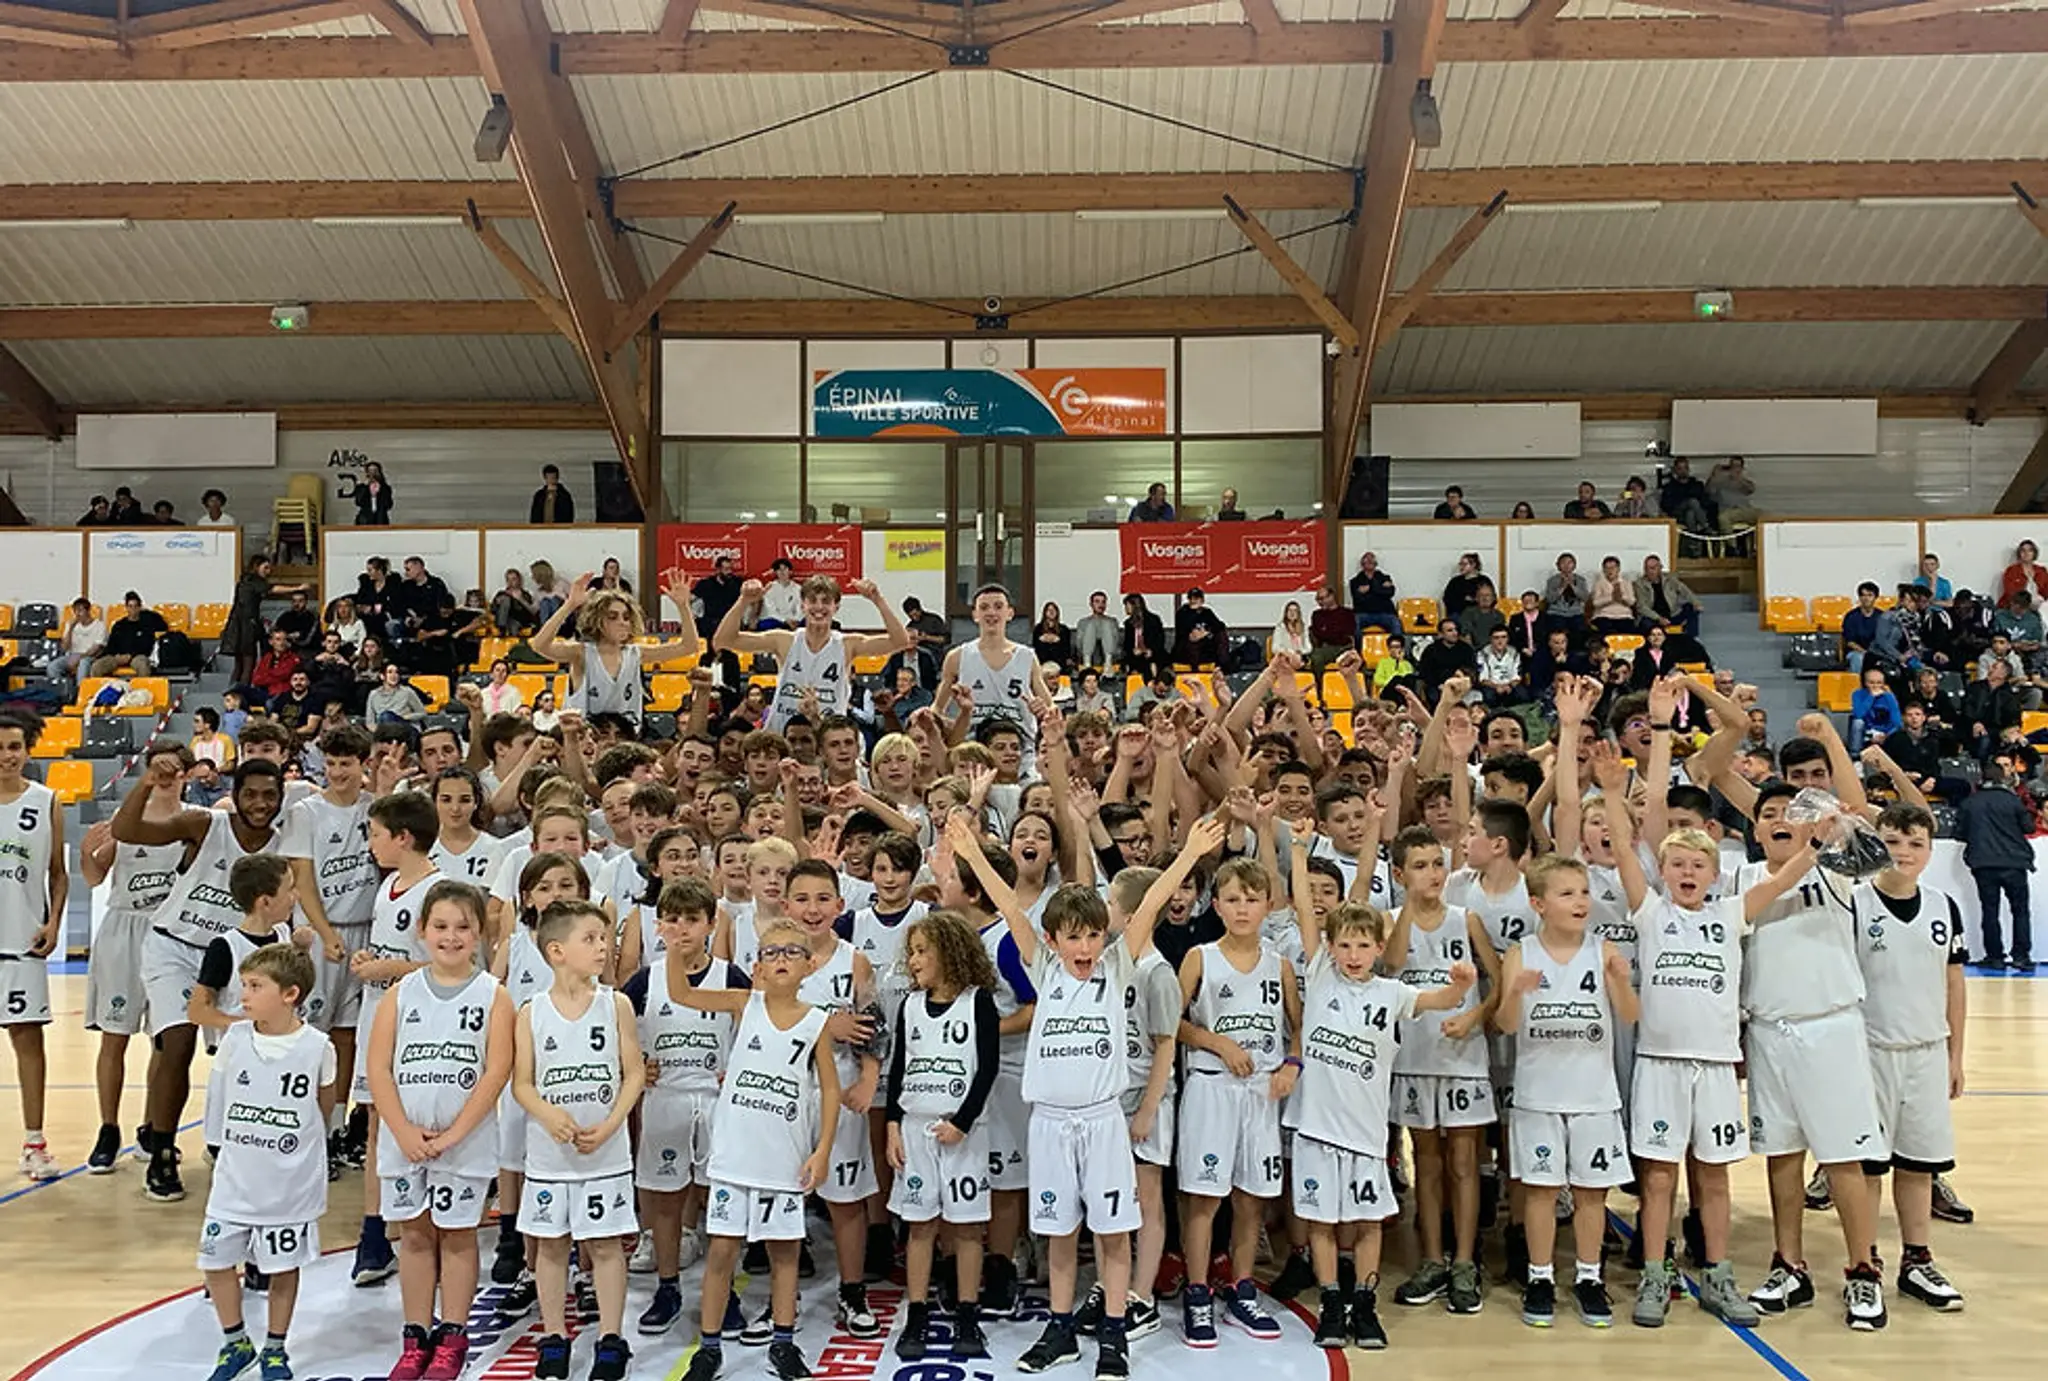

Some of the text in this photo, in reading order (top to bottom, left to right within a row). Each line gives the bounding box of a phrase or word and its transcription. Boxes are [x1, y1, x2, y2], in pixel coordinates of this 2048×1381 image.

[852, 405, 980, 421] VILLE SPORTIVE
[681, 544, 741, 567] Vosges
[784, 544, 845, 564] Vosges
[1143, 543, 1205, 562] Vosges
[1247, 541, 1309, 560] Vosges
[822, 662, 839, 682] 4
[1007, 678, 1023, 699] 5
[18, 807, 39, 831] 5
[1799, 882, 1826, 908] 11
[395, 908, 411, 932] 9
[1501, 915, 1525, 942] 12
[1930, 919, 1948, 946] 8
[1699, 923, 1723, 944] 19
[1440, 939, 1464, 961] 16
[830, 973, 853, 998] 17
[1089, 978, 1106, 1002] 7
[1259, 980, 1281, 1006] 15
[1580, 970, 1597, 993] 4
[1652, 974, 1709, 989] E.Leclerc
[8, 990, 27, 1014] 5
[458, 1005, 484, 1032] 13
[1363, 1002, 1387, 1031] 14
[589, 1026, 606, 1051] 5
[942, 1020, 969, 1044] 10
[1530, 1026, 1585, 1041] E.Leclerc
[788, 1039, 806, 1067] 7
[280, 1072, 310, 1099] 18
[1446, 1088, 1470, 1111] 16
[1711, 1122, 1735, 1146] 19
[988, 1151, 1004, 1176] 5
[1263, 1155, 1282, 1182] 15
[1590, 1147, 1608, 1172] 4
[835, 1161, 859, 1187] 17
[426, 1183, 453, 1212] 13
[949, 1176, 978, 1203] 10
[1350, 1180, 1378, 1205] 14
[587, 1194, 605, 1221] 5
[758, 1196, 775, 1224] 7
[1103, 1189, 1120, 1217] 7
[265, 1229, 298, 1255] 18
